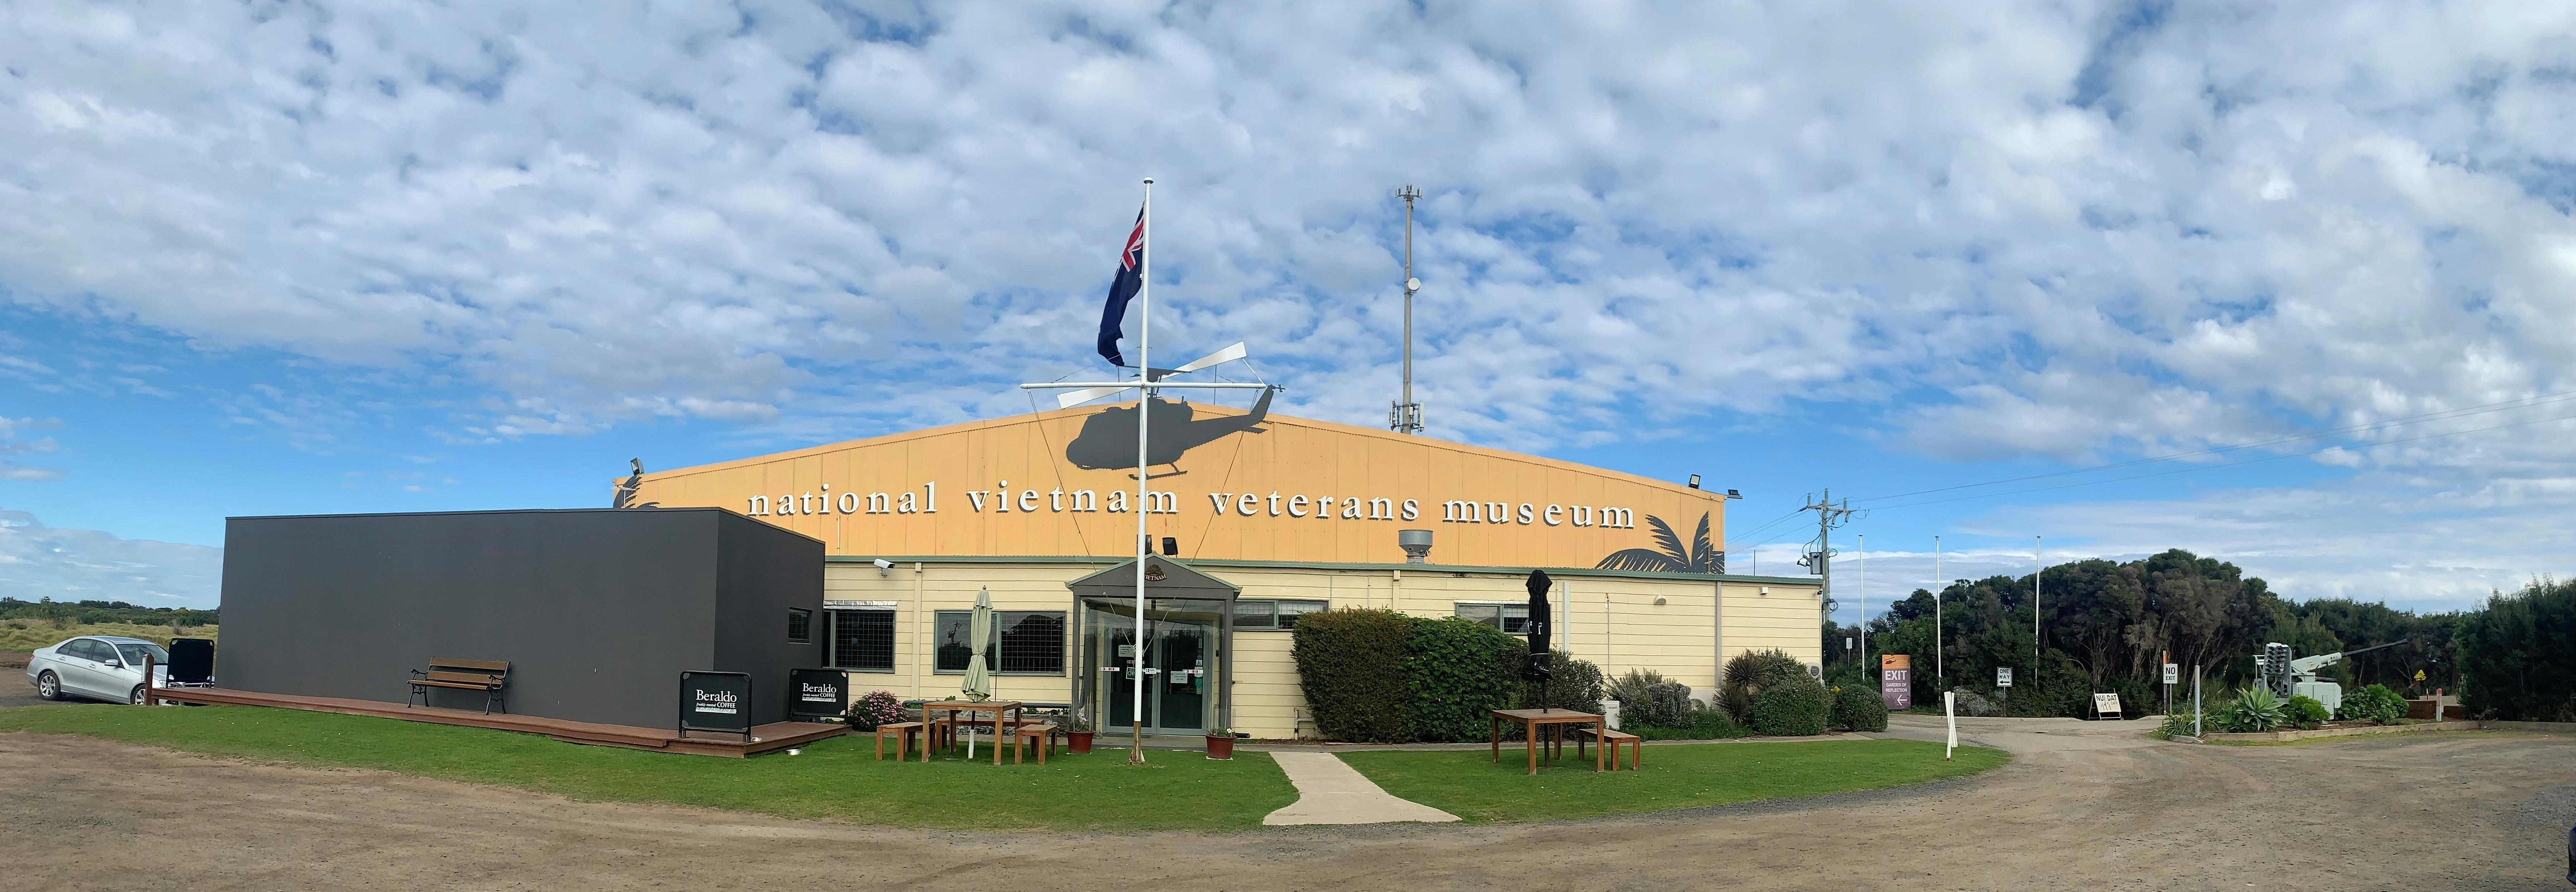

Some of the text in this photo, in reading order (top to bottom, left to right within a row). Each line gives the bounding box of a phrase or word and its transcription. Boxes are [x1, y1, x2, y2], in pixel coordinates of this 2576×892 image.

[748, 480, 1636, 529] national vietnam veterans museum
[1885, 670, 1907, 680] EXIT
[802, 683, 836, 693] Beraldo
[696, 689, 737, 702] Beraldo
